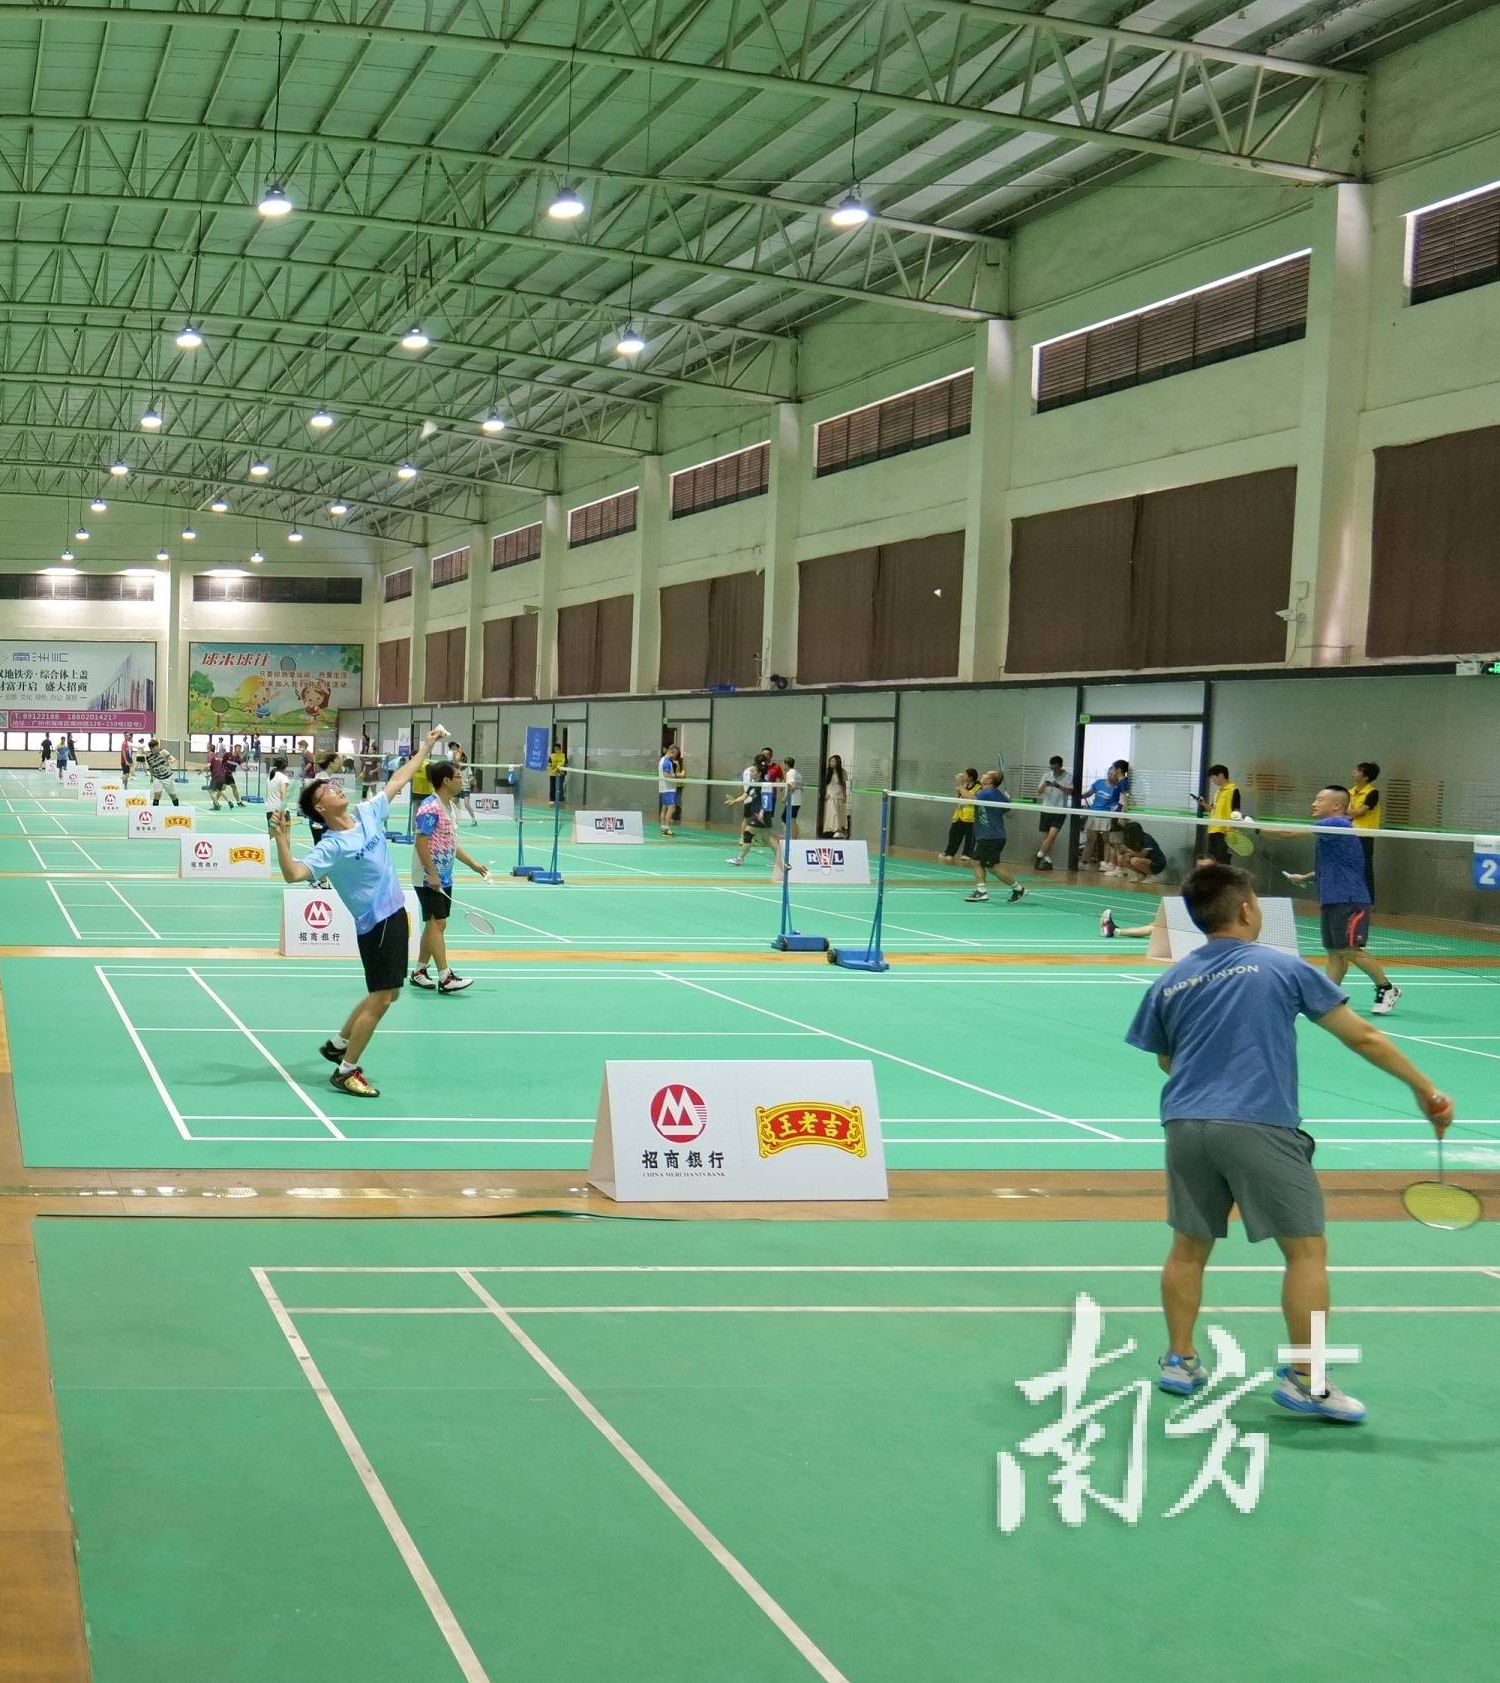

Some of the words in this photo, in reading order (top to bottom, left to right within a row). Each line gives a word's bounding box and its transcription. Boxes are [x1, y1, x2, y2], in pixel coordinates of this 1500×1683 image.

[202, 653, 269, 666] 球来球往
[45, 682, 88, 692] 盛大招商
[763, 794, 769, 809] 3
[806, 850, 844, 865] RSL
[1479, 859, 1496, 885] 2
[299, 931, 340, 941] 招商银行
[778, 1111, 842, 1138] 王老吉
[642, 1149, 724, 1169] 招商银行
